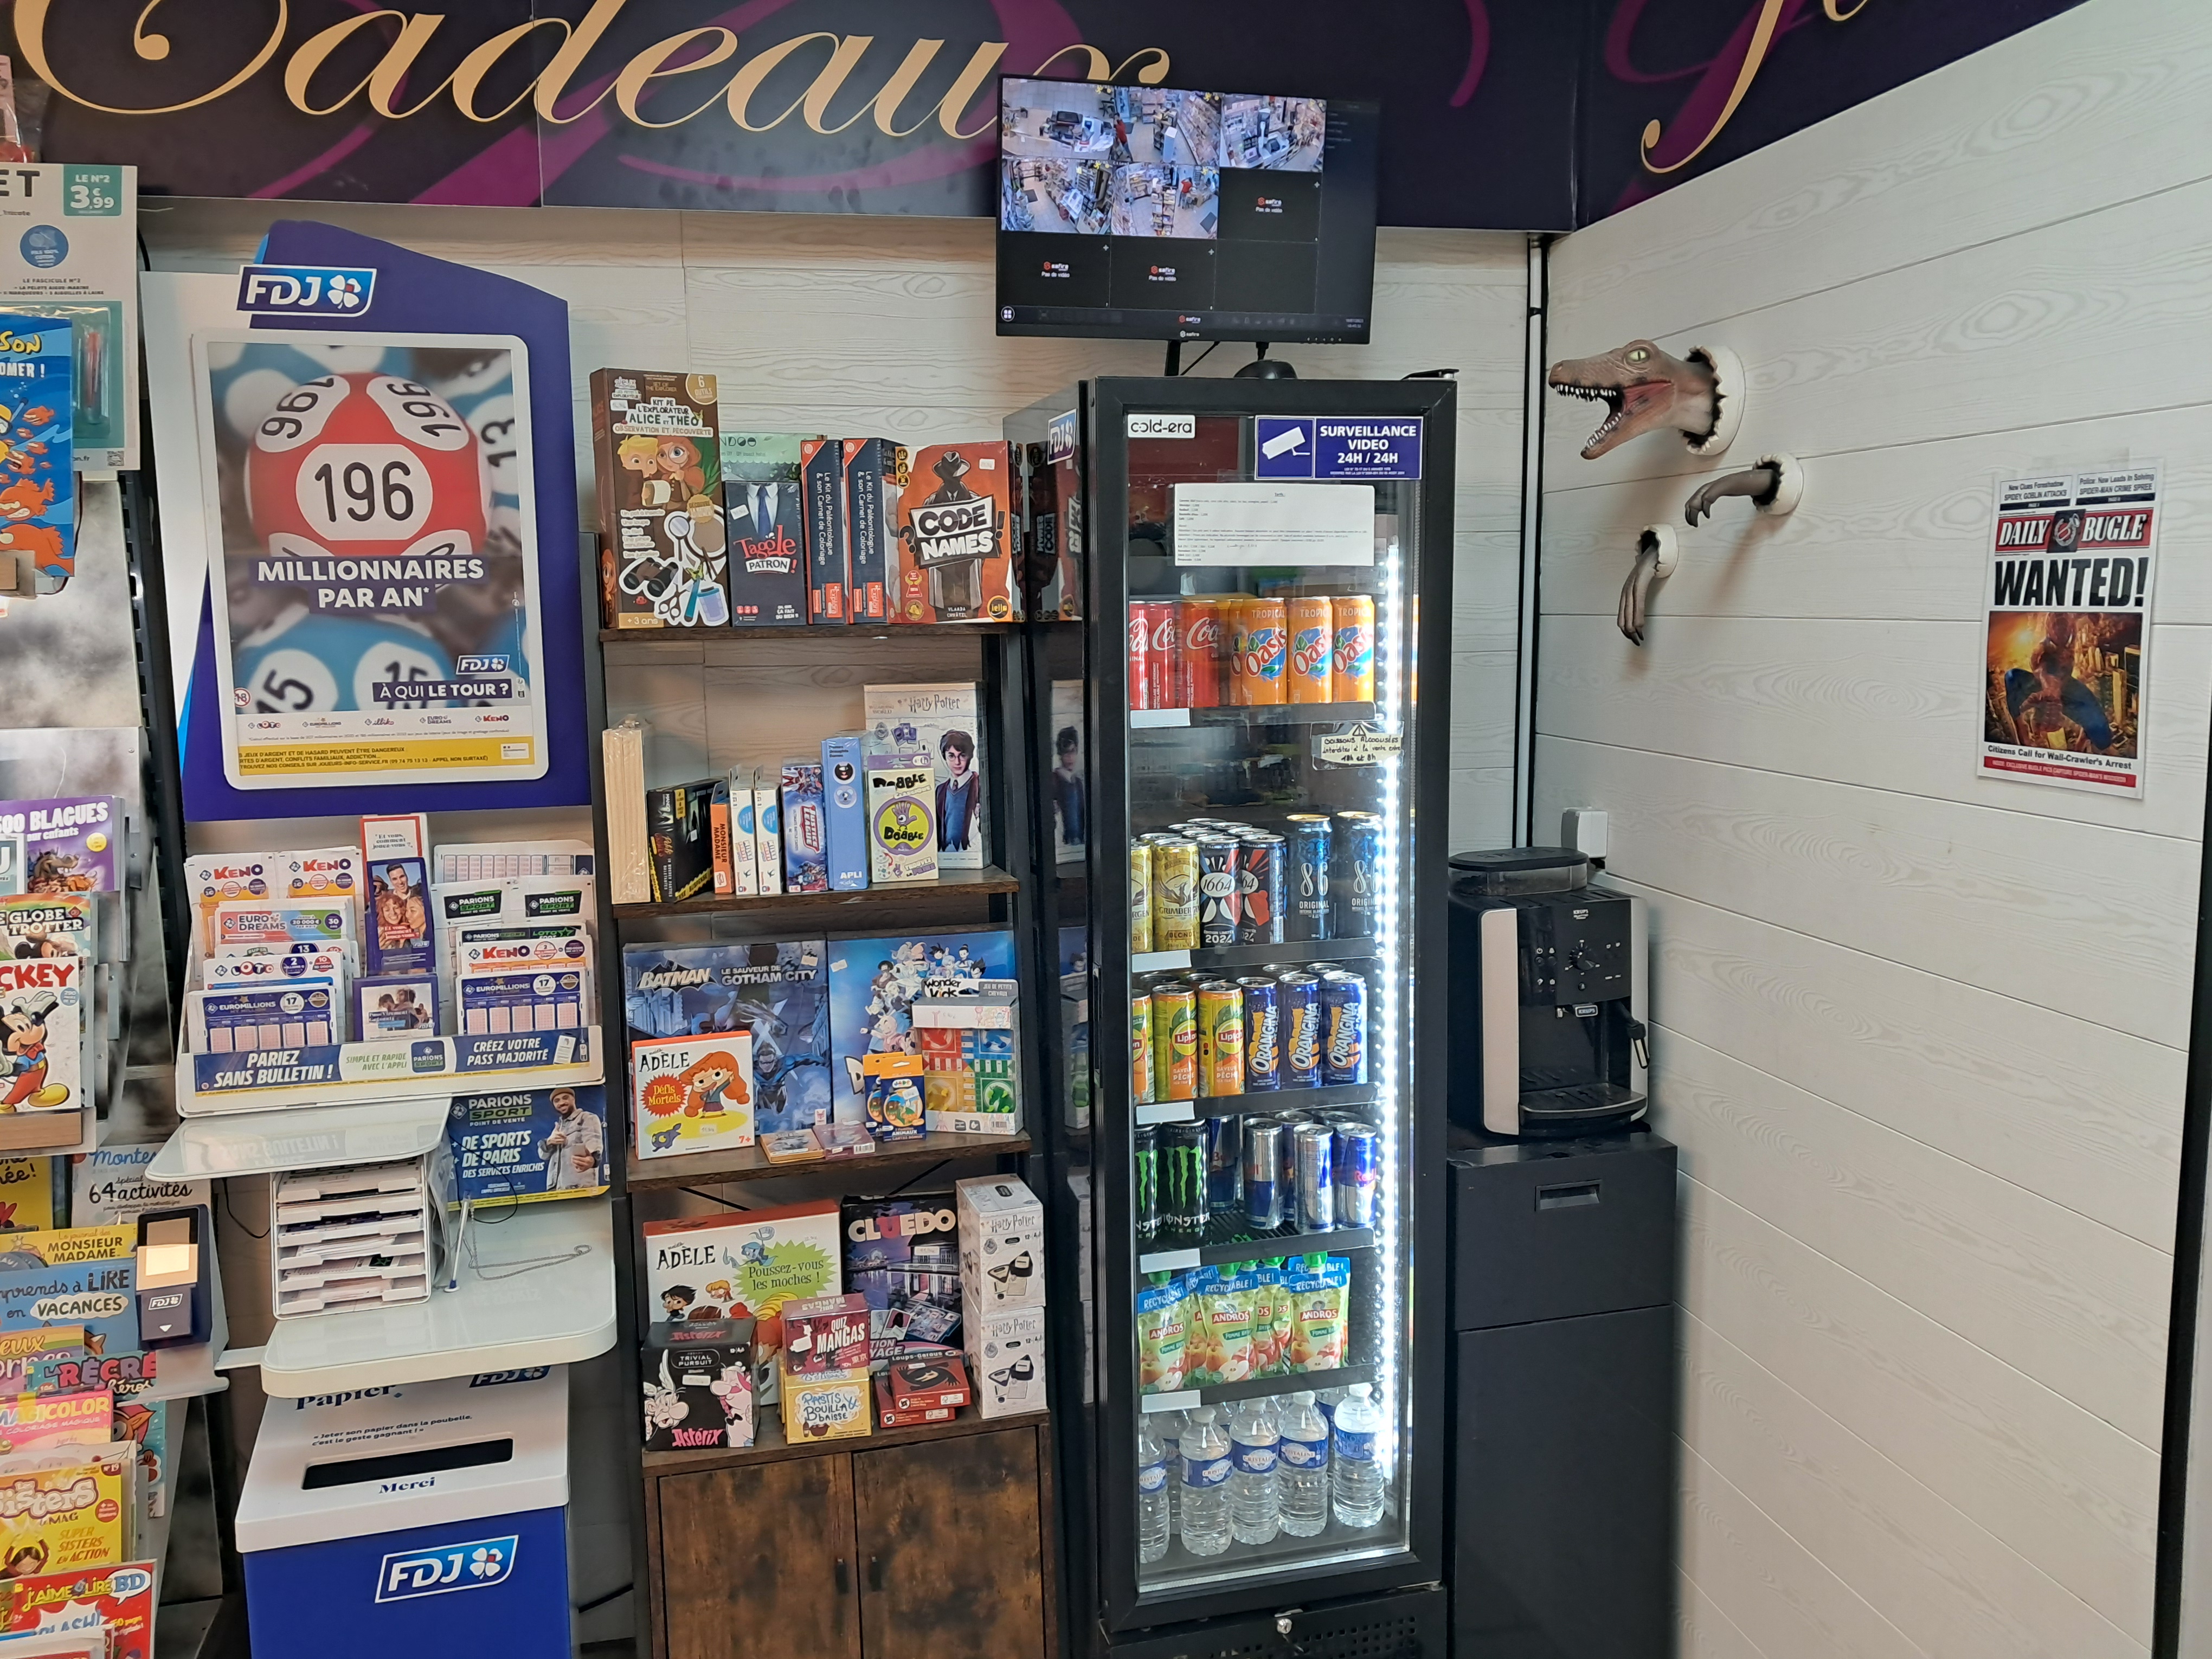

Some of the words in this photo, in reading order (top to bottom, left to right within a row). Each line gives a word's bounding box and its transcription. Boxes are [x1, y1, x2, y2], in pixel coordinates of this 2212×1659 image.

[246, 274, 322, 306] FDJ
[698, 375, 705, 388] 6
[694, 388, 713, 396] OUTILS
[638, 406, 689, 415] L'EXPLORATEUR
[1130, 419, 1192, 434] cold-era
[1319, 425, 1417, 438] SURVEILLANCE
[1049, 423, 1064, 457] FDJ
[1348, 438, 1390, 451] VIDEO
[1337, 452, 1362, 464] 24H
[1373, 452, 1399, 464] 24H
[824, 472, 831, 482] Le
[314, 460, 414, 523] 196
[2079, 486, 2113, 495] SPIDER-MAN
[2114, 485, 2132, 493] CRIME
[2133, 483, 2153, 491] SPREE
[825, 493, 833, 504] du
[818, 519, 824, 530] de
[918, 504, 987, 536] CODE
[826, 505, 834, 556] Paléontologue
[1998, 519, 2051, 546] DAILY
[2081, 513, 2147, 542] BUGLE
[818, 531, 826, 566] Coloriage
[921, 530, 994, 561] NAMES
[258, 558, 484, 581] MILLIONNAIRES
[749, 559, 788, 570] PATRON
[1994, 557, 2150, 607] WANTED!
[318, 588, 375, 608] PAR
[1251, 609, 1285, 619] TROPICAL
[1246, 626, 1287, 677] Oasis
[460, 658, 490, 672] FDJ
[380, 684, 391, 699] À
[394, 686, 425, 699] QUI
[428, 685, 447, 698] LE
[451, 683, 496, 697] TOUR
[499, 683, 509, 695] ?
[909, 695, 933, 713] Harry
[934, 694, 961, 713] Potter
[1988, 744, 2016, 756] Citizens
[2017, 748, 2033, 758] Call
[2034, 750, 2046, 759] for
[2047, 751, 2103, 767] Wall-Crawler's
[2105, 758, 2132, 770] Arrest
[30, 801, 109, 831] BLAGUES
[43, 827, 79, 840] enfants
[803, 806, 812, 847] LEAGUE
[719, 822, 728, 864] MONSIEUR
[214, 864, 263, 880] KENO
[840, 871, 863, 879] APLI
[1203, 875, 1233, 891] 1664
[539, 895, 575, 905] PARIONS
[1299, 901, 1329, 910] ORIGINAL
[9, 908, 65, 923] GLOBE
[239, 915, 269, 923] EURO
[9, 919, 83, 936] TROTTER
[239, 922, 286, 931] DREAMS
[1205, 934, 1232, 943] 2024
[482, 945, 531, 960] KENO
[721, 974, 782, 986] GOTHAM
[785, 969, 818, 981] CITY
[732, 966, 770, 974] SAUVEUR
[638, 968, 712, 990] BATMAN
[923, 978, 962, 988] Wonder
[218, 1000, 276, 1011] EUROMILLIONS
[286, 996, 297, 1006] 17
[1578, 1007, 1596, 1015] KRUPS
[473, 1039, 505, 1053] CRÉEZ
[507, 1037, 542, 1050] VOTRE
[1251, 1005, 1277, 1072] ORANGINA
[246, 1050, 301, 1068] PARIEZ
[346, 1054, 370, 1064] SIMPLE
[372, 1054, 380, 1063] ET
[382, 1052, 407, 1062] RAPIDE
[467, 1053, 494, 1066] PASS
[496, 1049, 549, 1064] MAJORITÉ
[639, 1051, 690, 1072] ADÈLE
[362, 1063, 380, 1072] AVEC
[381, 1061, 408, 1070] L'APPLI
[213, 1070, 254, 1088] SANS
[256, 1065, 324, 1085] BULLETIN
[326, 1064, 334, 1079] !
[653, 1084, 676, 1096] Défis
[648, 1092, 681, 1106] Mortels
[471, 1107, 530, 1120] SPORT
[461, 1136, 479, 1152] DE
[480, 1130, 532, 1149] SPORTS
[461, 1152, 480, 1168] DE
[481, 1147, 522, 1166] PARIS
[462, 1169, 477, 1179] DES
[477, 1165, 511, 1177] SERVICES
[511, 1161, 545, 1174] ENRICHIS
[88, 1181, 117, 1204] 64
[117, 1182, 193, 1200] activités
[848, 1208, 956, 1243] CLUEDO
[48, 1237, 123, 1252] MONSIEUR
[54, 1248, 117, 1262] MADAME
[656, 1245, 716, 1270] ADÈLE
[748, 1259, 824, 1279] Poussez-vous
[751, 1276, 768, 1291] les
[770, 1272, 812, 1288] moches
[815, 1269, 820, 1283] !
[7, 1309, 26, 1319] en
[37, 1296, 123, 1317] VACANCES
[1301, 1309, 1338, 1320] ANDROS
[831, 1316, 848, 1333] QUIZ
[1149, 1323, 1185, 1339] ANDROS
[816, 1322, 866, 1355] MANGAS
[892, 1351, 943, 1361] Loups-Garous
[475, 1369, 522, 1385] FDJ
[108, 1380, 154, 1395] héros
[7, 1422, 59, 1435] COLORIAGE
[61, 1416, 100, 1427] MAGIQUE
[671, 1427, 723, 1448] Astérix
[379, 1476, 436, 1495] Merci
[59, 1526, 95, 1540] SUPER
[58, 1536, 105, 1553] SISTERS
[69, 1548, 111, 1562] ACTION
[387, 1553, 465, 1592] FDJ
[114, 1573, 146, 1593] BD
